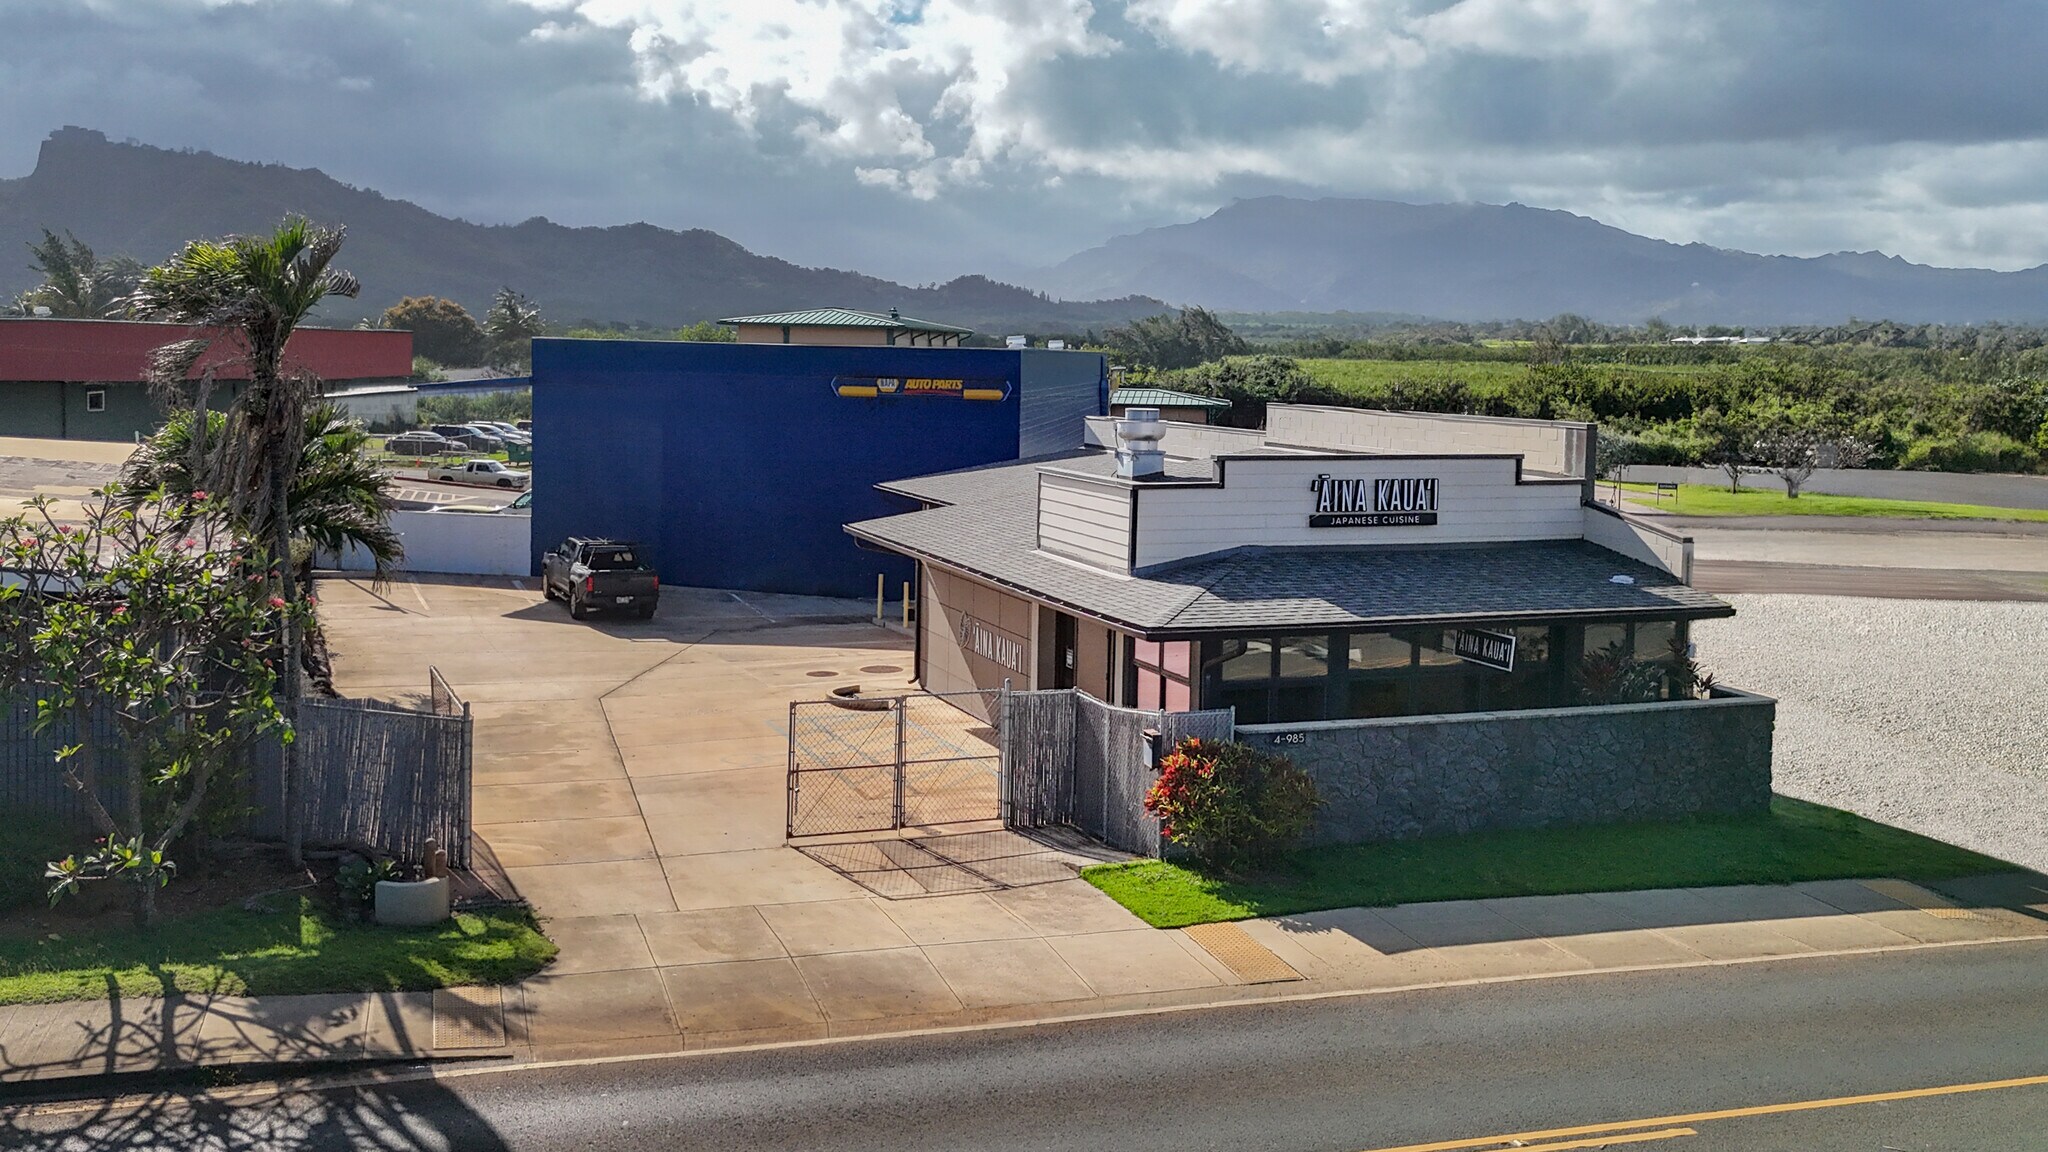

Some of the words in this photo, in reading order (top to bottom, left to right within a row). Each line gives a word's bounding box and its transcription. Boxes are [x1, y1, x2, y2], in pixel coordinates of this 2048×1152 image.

[905, 379, 931, 389] AUTO
[932, 379, 963, 390] PARTS
[1330, 516, 1379, 525] JAPANESE
[1382, 514, 1420, 524] CUISINE
[1273, 733, 1305, 744] 4-985
